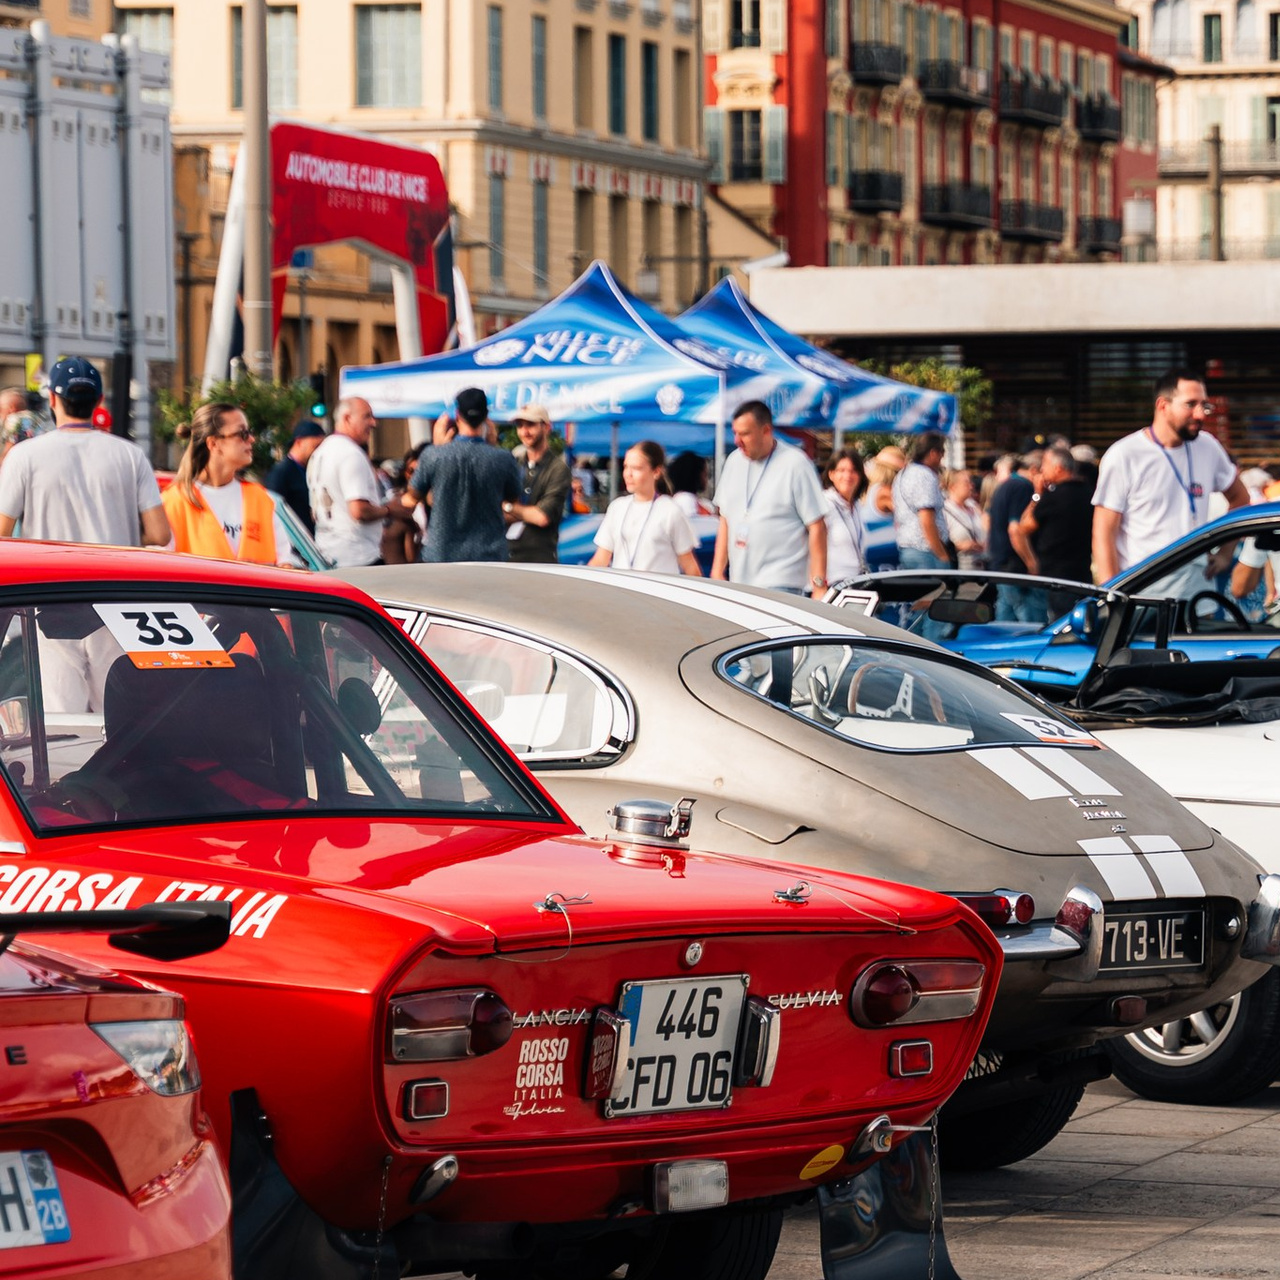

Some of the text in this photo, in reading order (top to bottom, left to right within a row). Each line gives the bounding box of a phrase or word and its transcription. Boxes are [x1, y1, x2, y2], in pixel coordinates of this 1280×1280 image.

[286, 151, 429, 203] AUTOMOBILE CLUB DE NICE
[120, 611, 194, 645] 35
[1021, 718, 1078, 738] 32
[1105, 918, 1185, 963] 713-VE
[656, 986, 723, 1041] 446
[767, 989, 840, 1010] FULVIA
[512, 1008, 589, 1028] LANCIA
[519, 1037, 570, 1064] ROSSO
[516, 1062, 564, 1089] CORSA
[686, 1050, 732, 1104] 06
[513, 1087, 563, 1102] ITALIA
[37, 1198, 66, 1231] 2B
